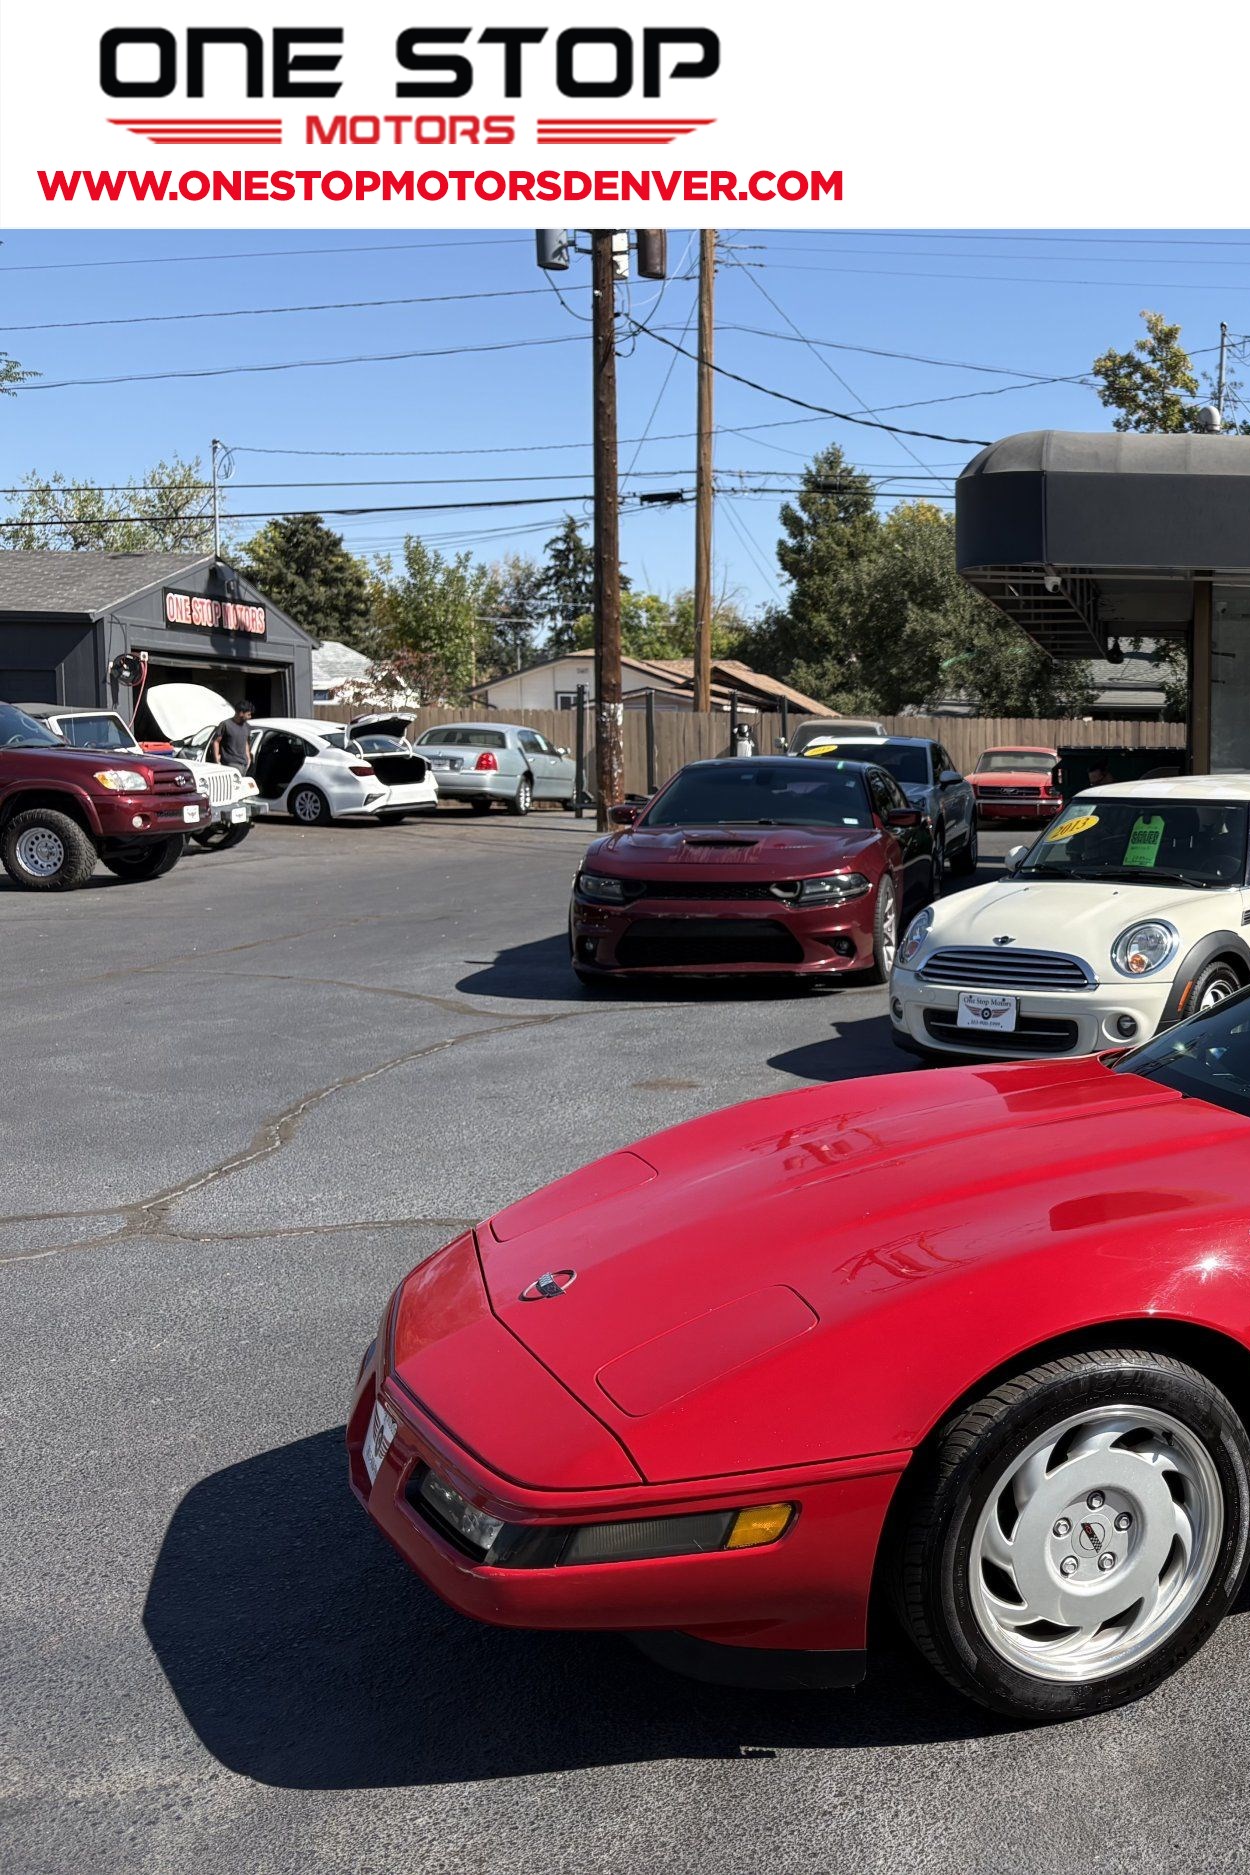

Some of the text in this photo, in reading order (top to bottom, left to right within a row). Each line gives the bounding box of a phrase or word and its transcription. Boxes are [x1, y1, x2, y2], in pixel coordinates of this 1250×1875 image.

[166, 592, 265, 634] ONE STOP MOTORS
